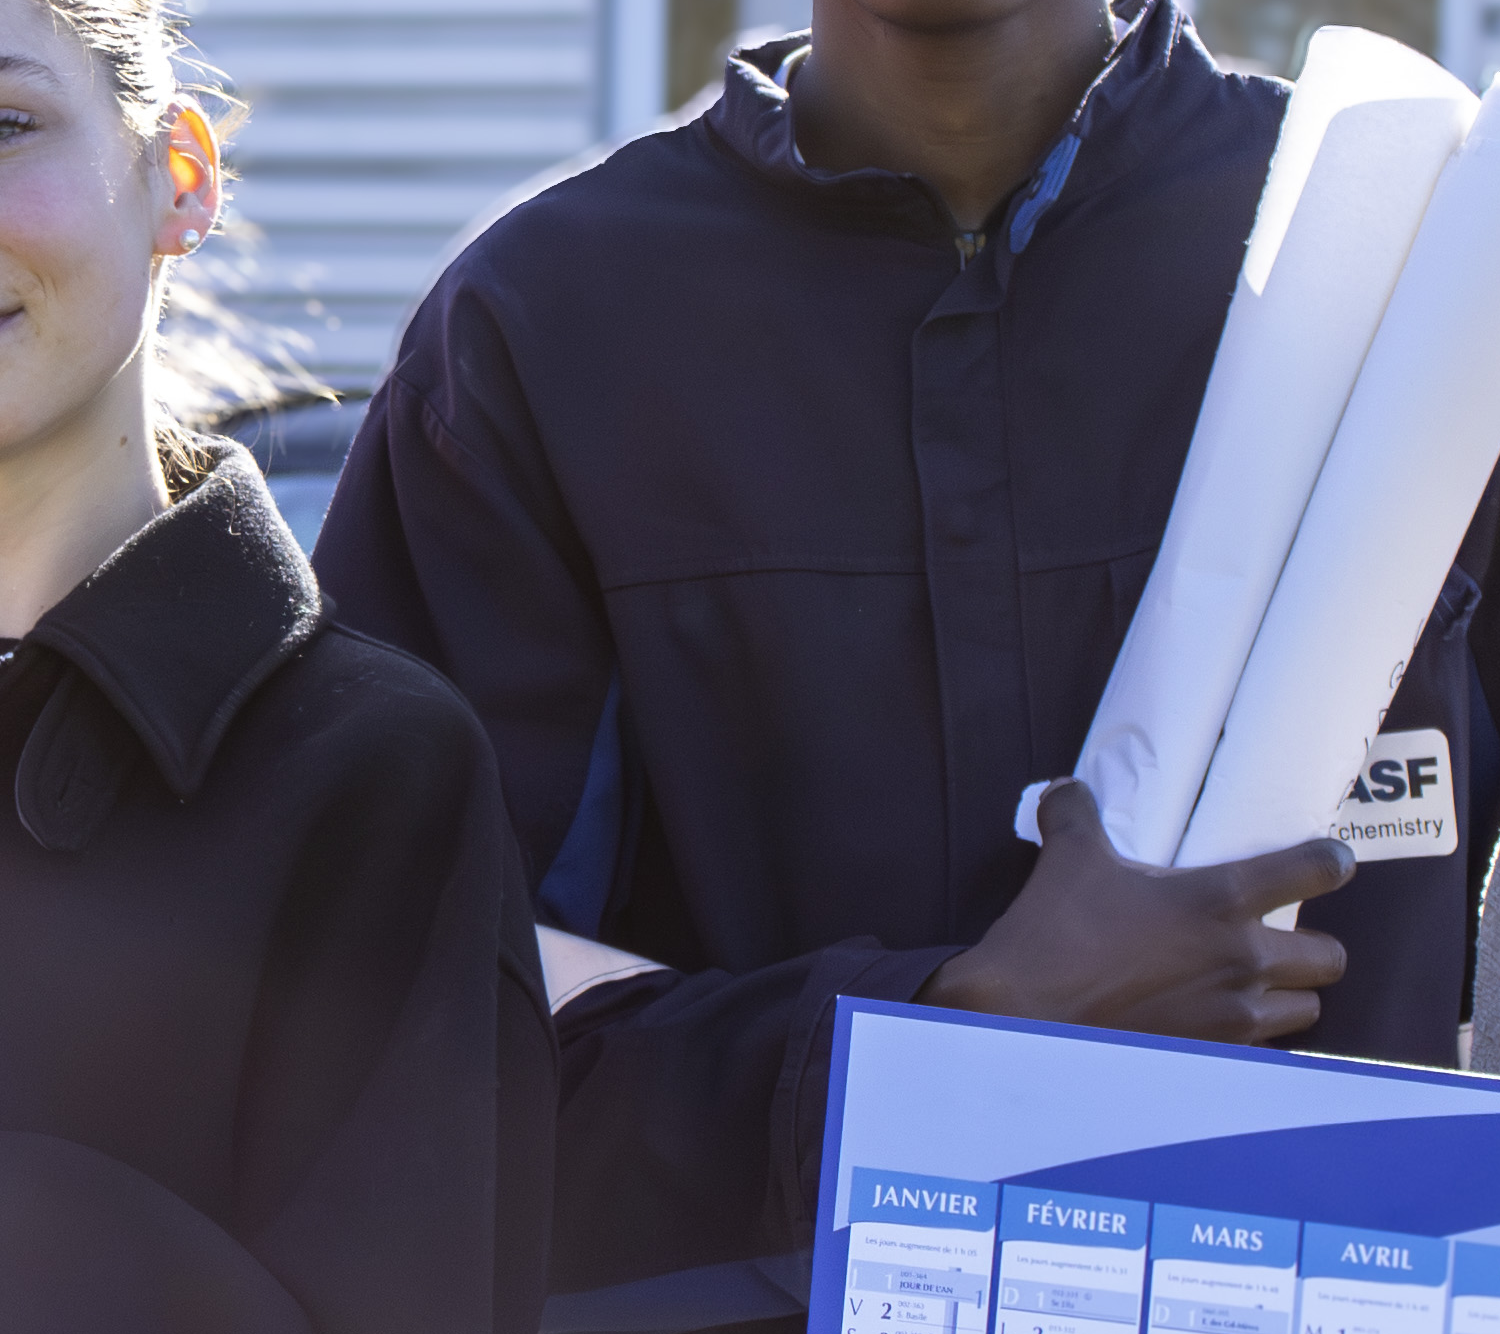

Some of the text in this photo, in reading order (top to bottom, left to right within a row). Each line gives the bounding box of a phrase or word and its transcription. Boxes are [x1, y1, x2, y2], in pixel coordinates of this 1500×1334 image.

[1347, 756, 1438, 803] ASF
[1338, 817, 1444, 842] chemistry
[873, 1183, 979, 1217] JANVIER
[1026, 1199, 1128, 1236] FÉVRIER
[1190, 1222, 1264, 1253] MARS
[1340, 1241, 1413, 1272] AVRIL
[899, 1281, 921, 1291] JOUR
[922, 1284, 934, 1292] DE
[849, 1297, 892, 1320] V 2
